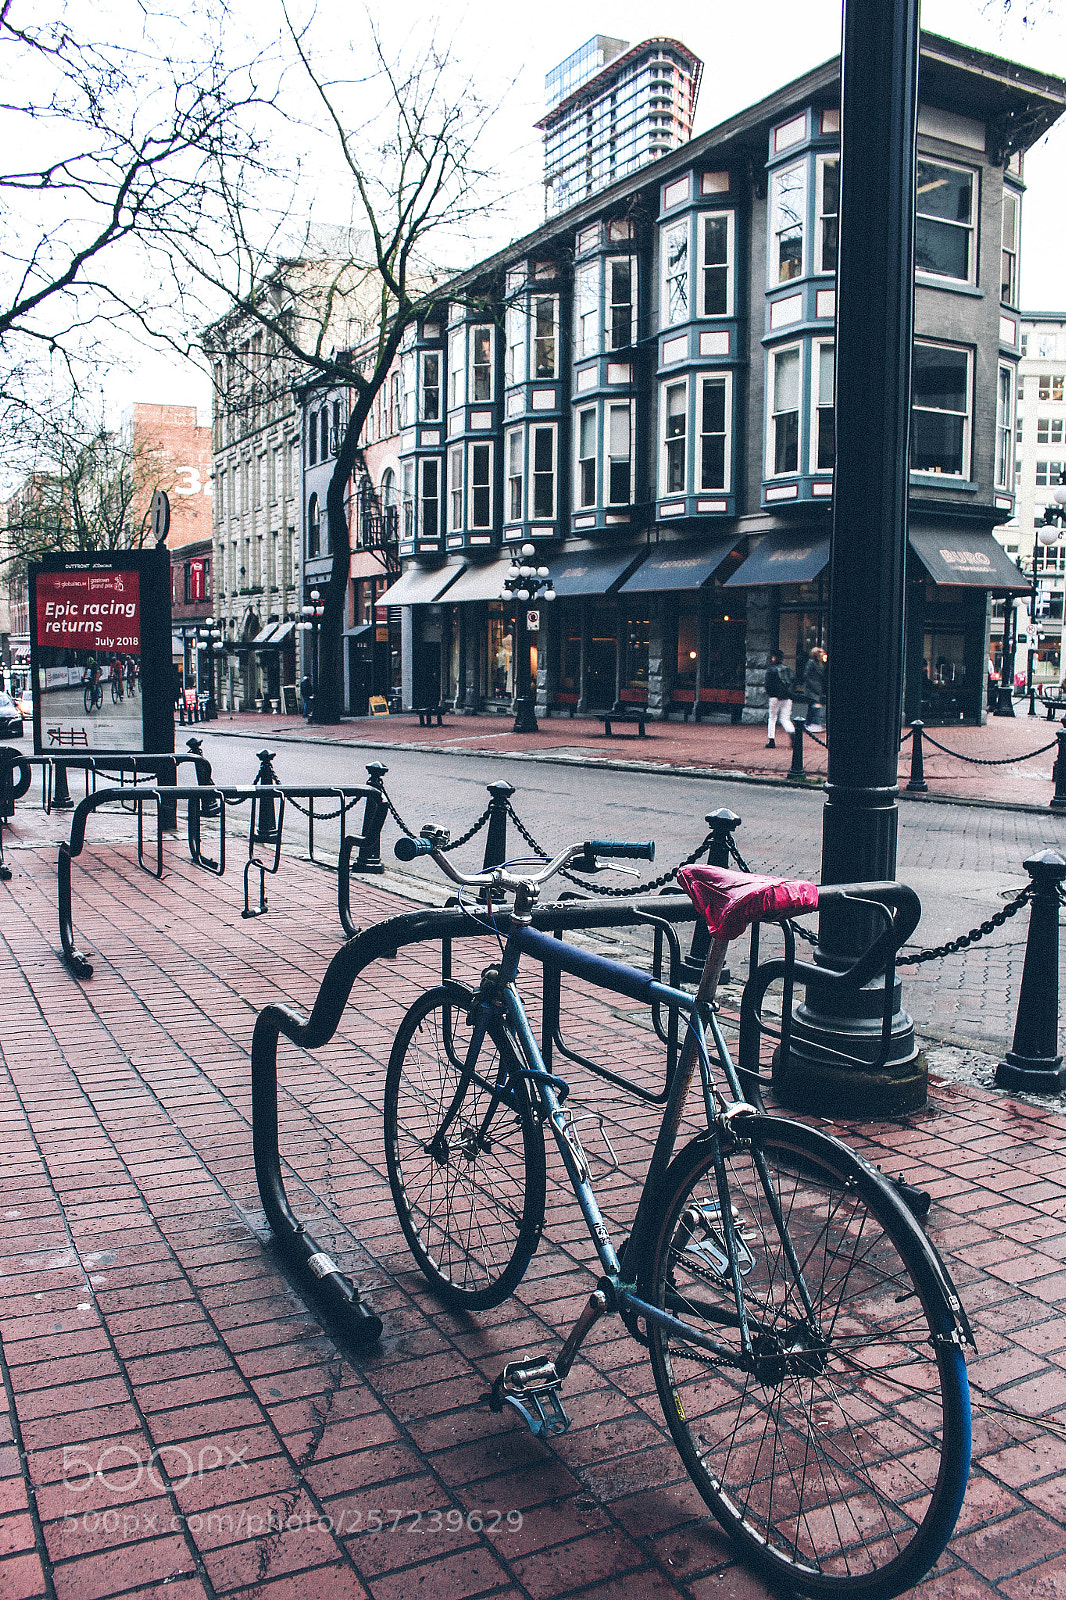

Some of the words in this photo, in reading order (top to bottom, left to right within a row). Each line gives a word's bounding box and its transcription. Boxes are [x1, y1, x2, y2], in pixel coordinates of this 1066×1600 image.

[940, 549, 991, 565] BURO
[45, 601, 78, 618] Epic
[83, 600, 136, 617] racing
[45, 620, 103, 632] returns
[95, 637, 114, 648] July
[116, 637, 139, 646] 2018
